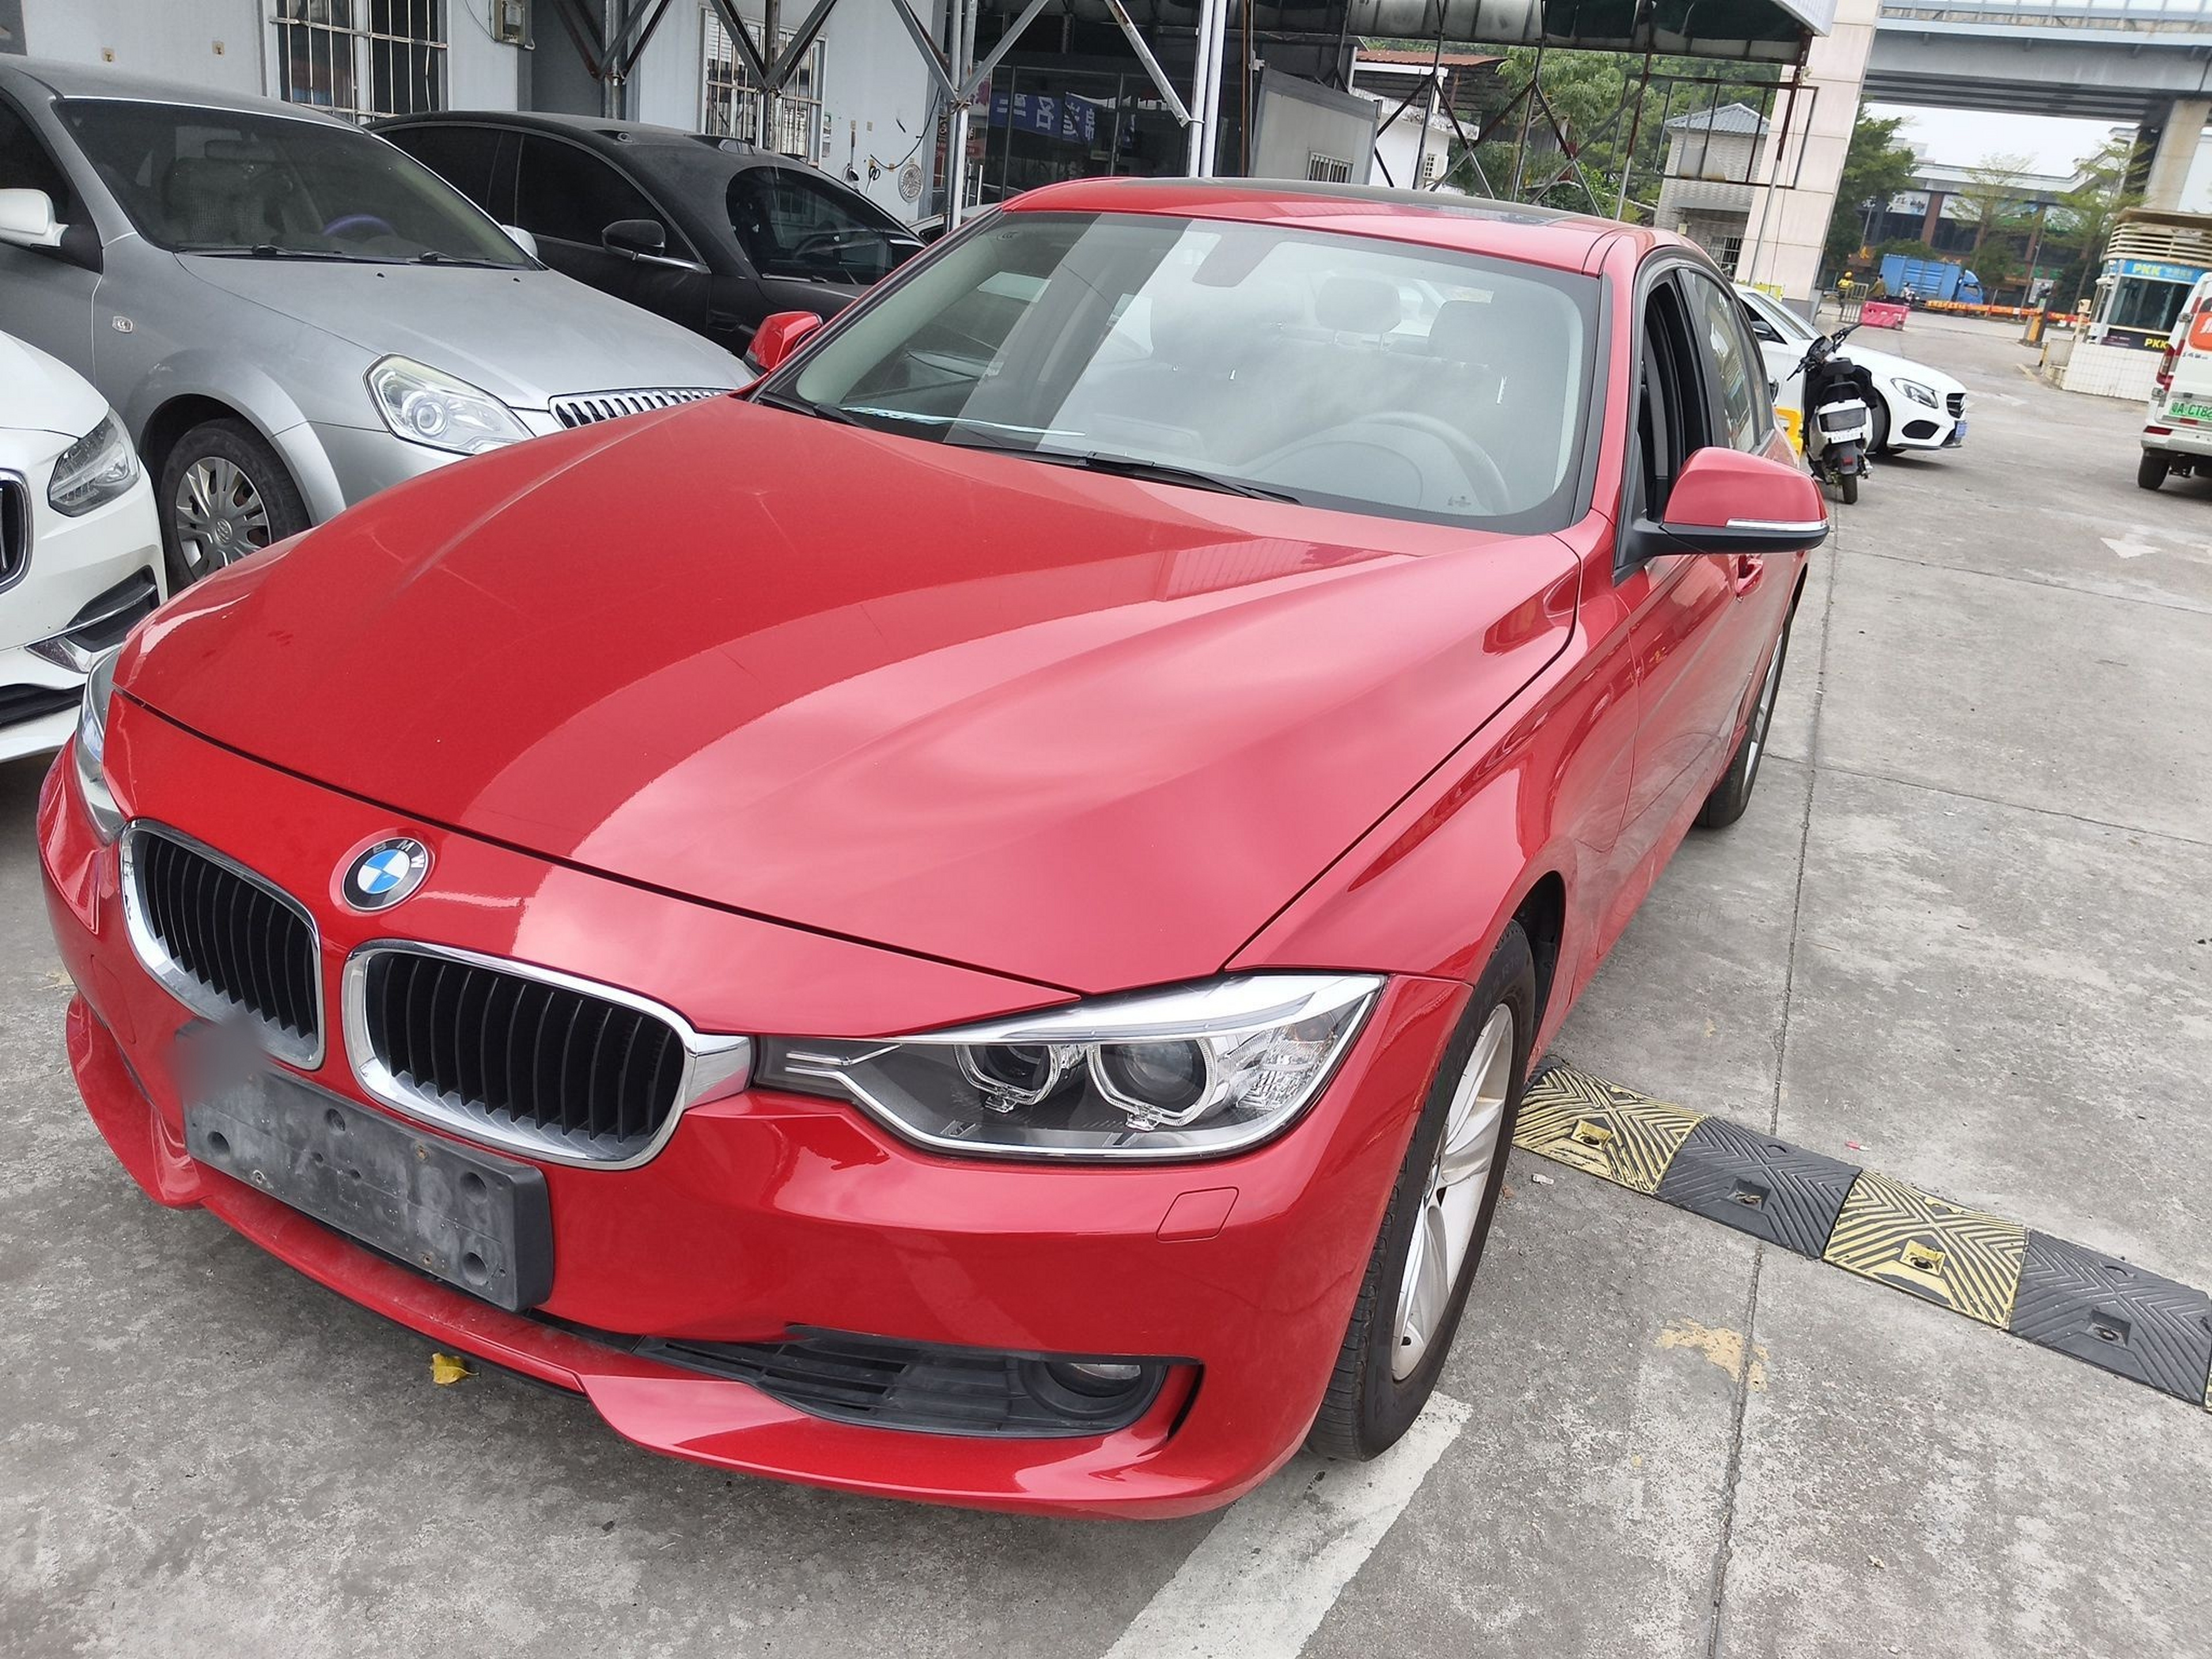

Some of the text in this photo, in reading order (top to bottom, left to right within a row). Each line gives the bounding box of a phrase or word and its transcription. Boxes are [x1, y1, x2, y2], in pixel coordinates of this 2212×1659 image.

[2133, 263, 2161, 276] PKK
[2144, 338, 2169, 349] PKK
[373, 840, 425, 868] BMW
